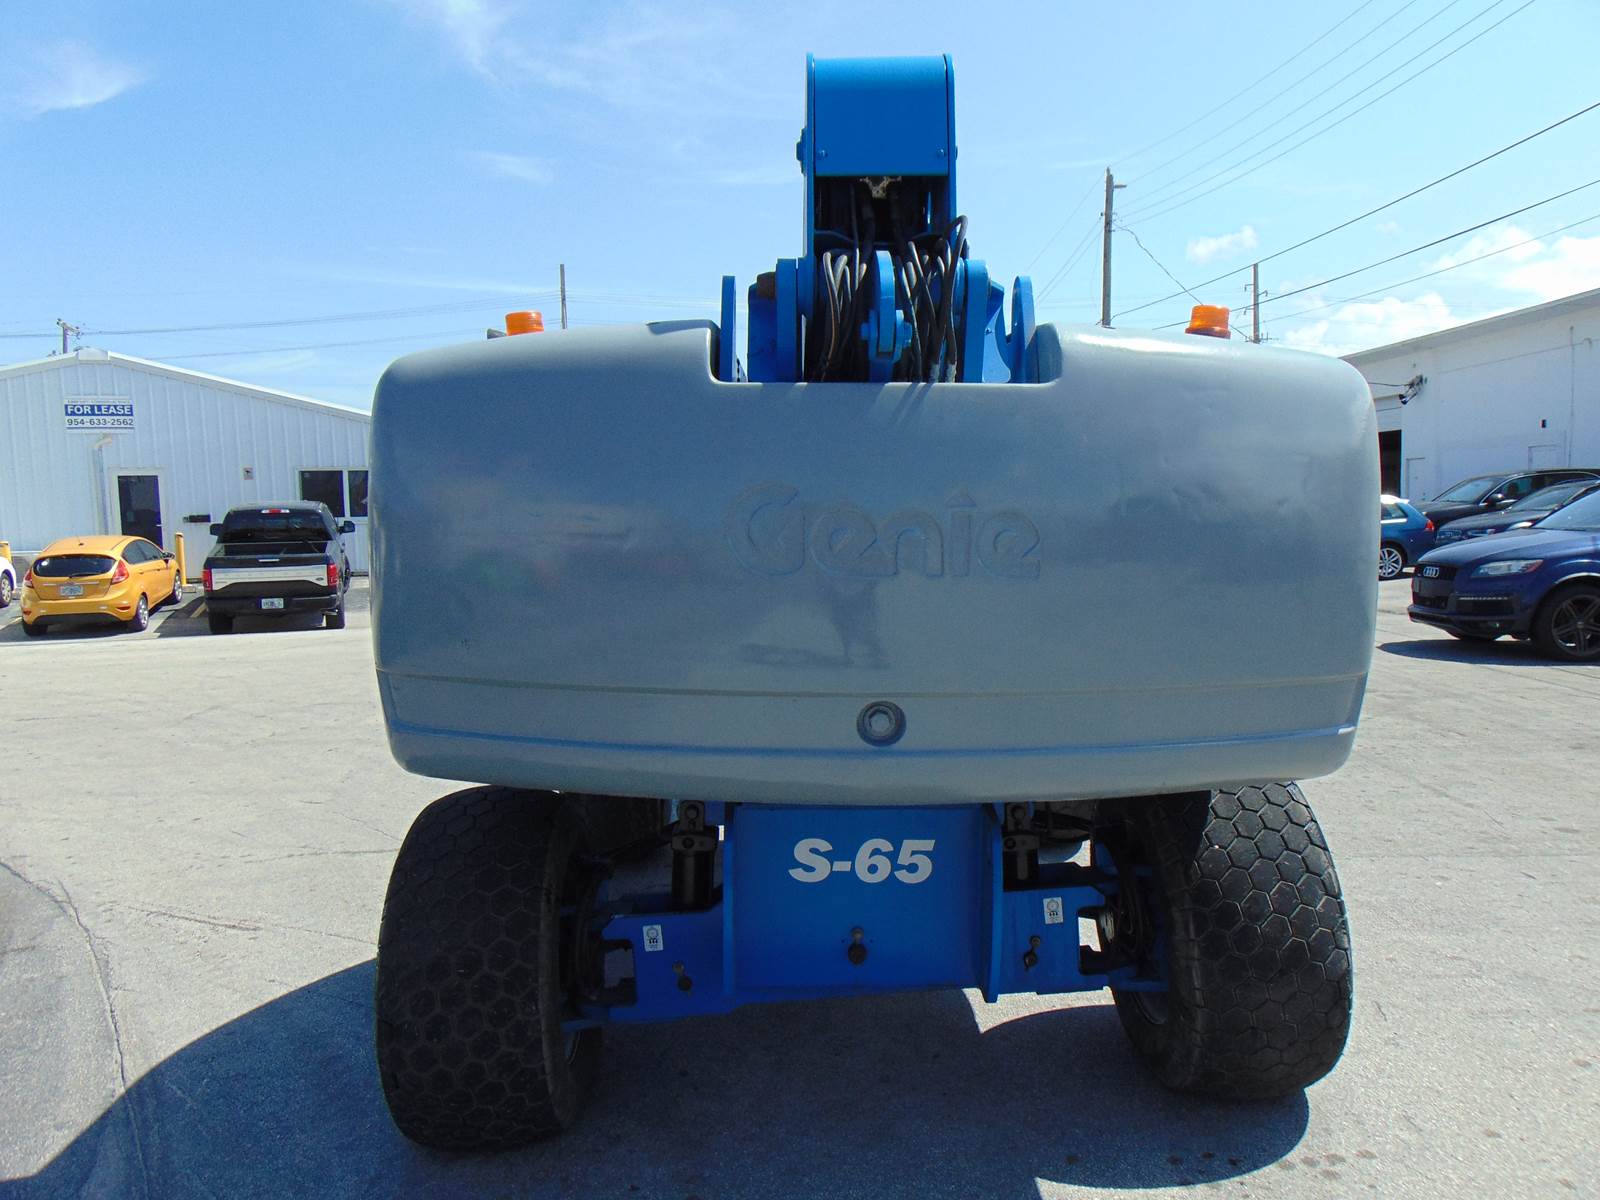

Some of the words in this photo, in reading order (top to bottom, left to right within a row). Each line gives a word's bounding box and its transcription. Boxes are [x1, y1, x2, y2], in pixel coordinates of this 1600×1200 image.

[67, 405, 91, 414] FOR
[94, 405, 131, 414] LEASE
[67, 418, 133, 426] 954-633-2562
[727, 481, 1041, 578] Genie
[788, 838, 936, 884] S-65
